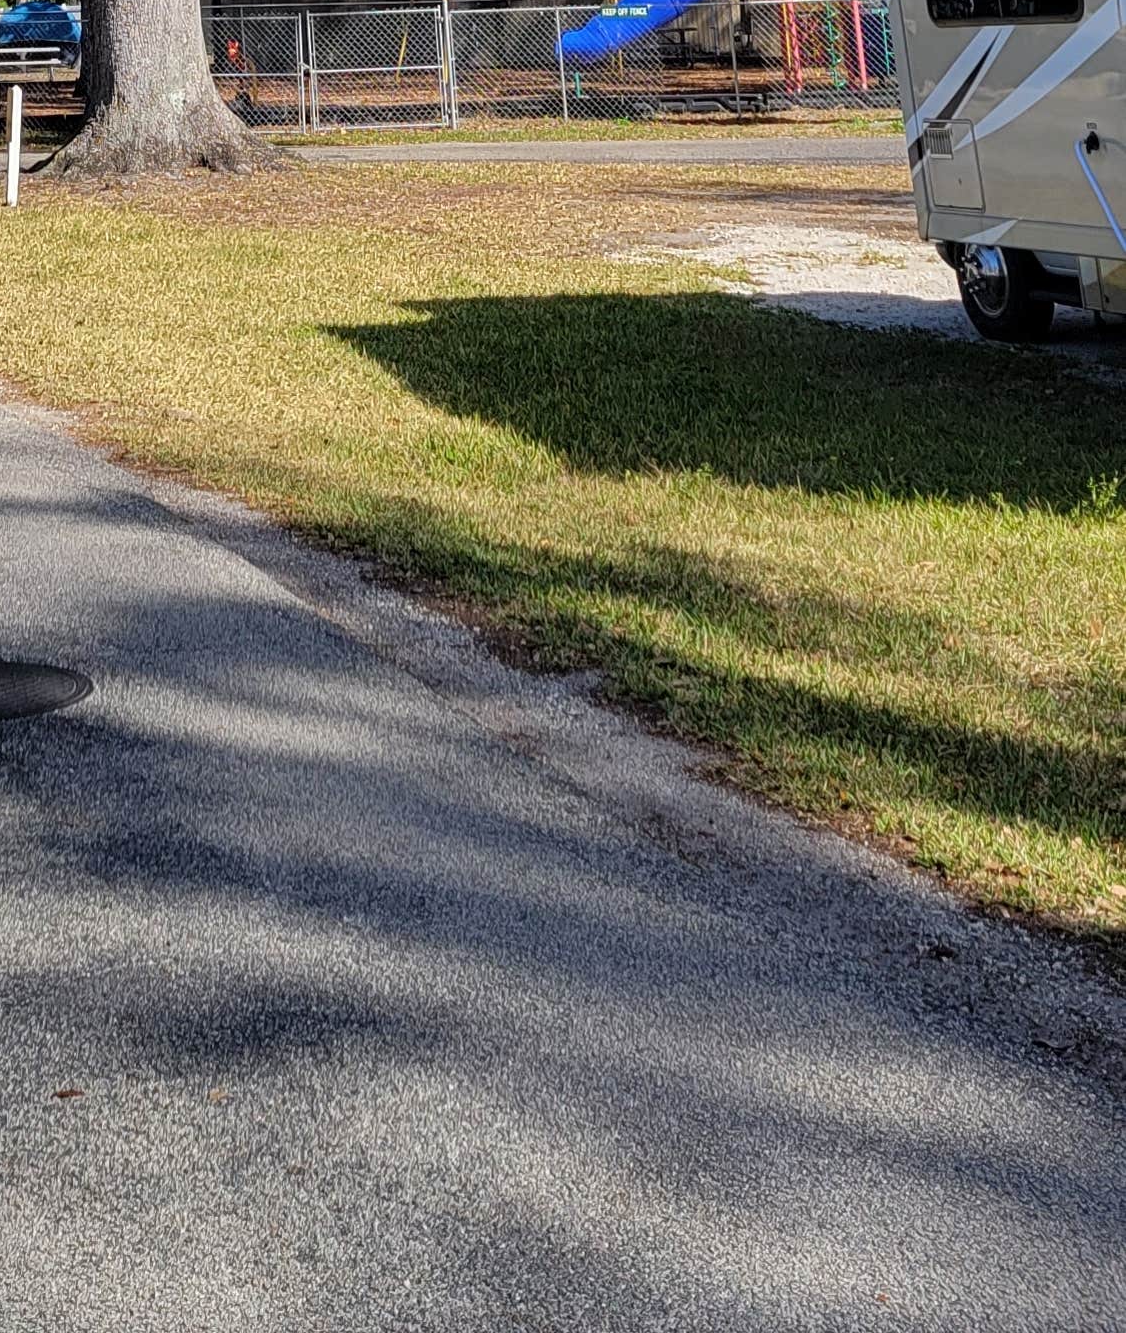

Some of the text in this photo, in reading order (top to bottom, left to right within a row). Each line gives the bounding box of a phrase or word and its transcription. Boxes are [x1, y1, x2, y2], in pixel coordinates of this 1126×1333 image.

[601, 7, 647, 16] KEEP OFF FENCE
